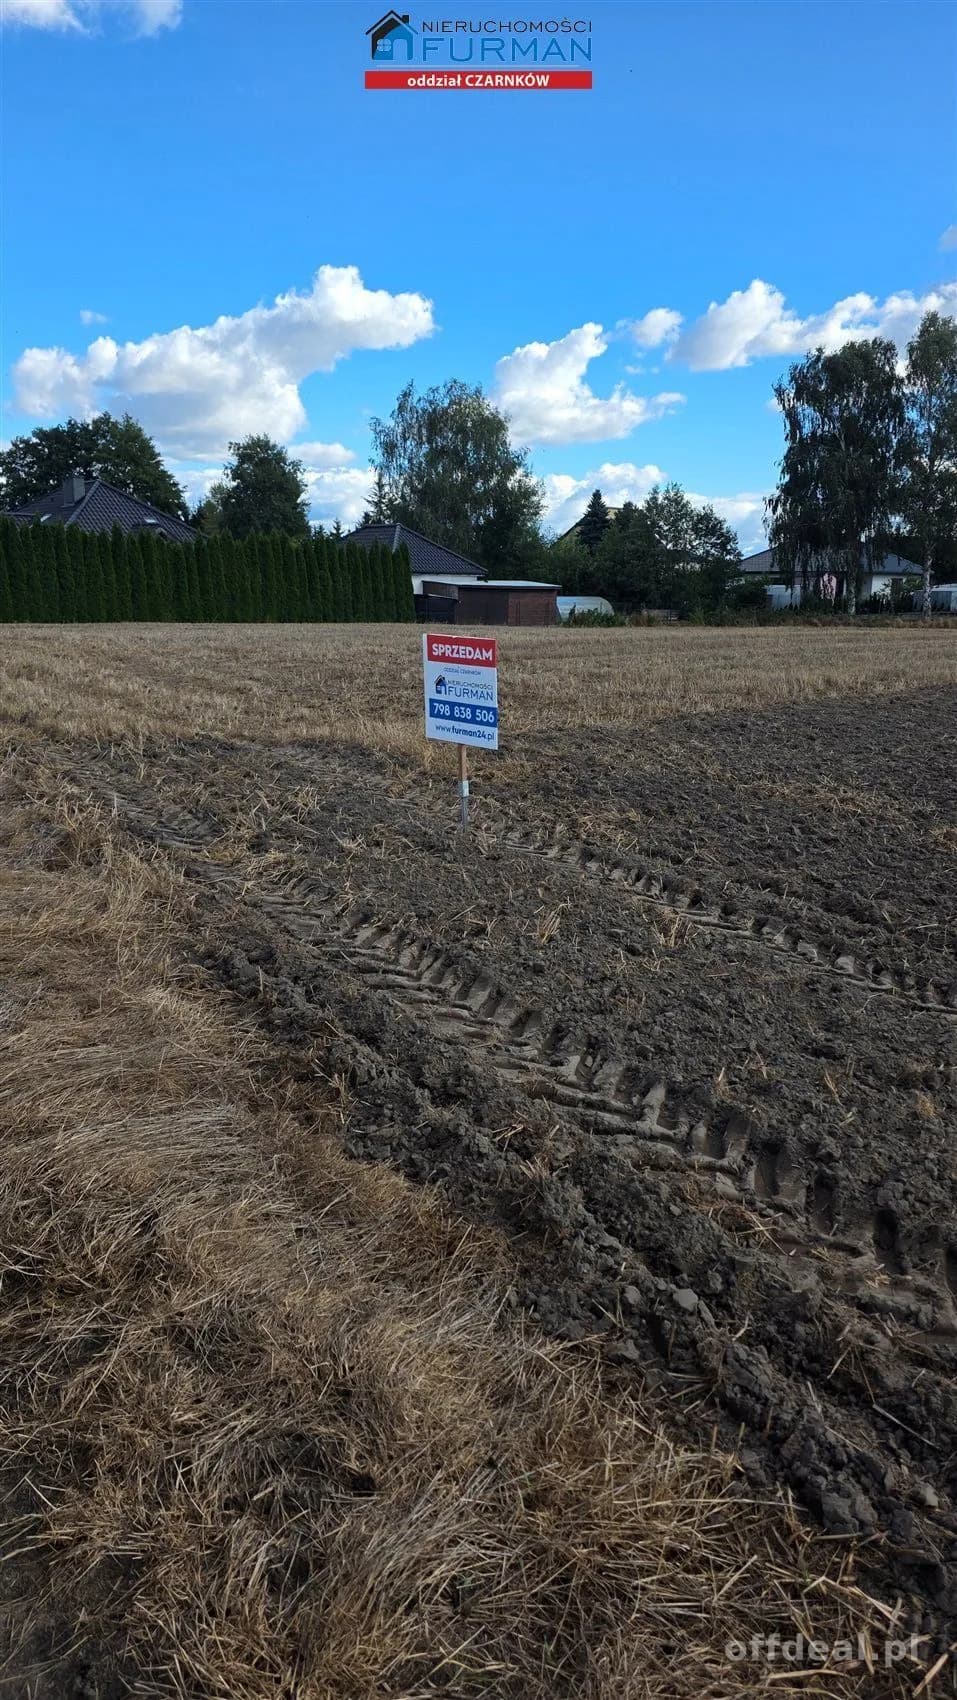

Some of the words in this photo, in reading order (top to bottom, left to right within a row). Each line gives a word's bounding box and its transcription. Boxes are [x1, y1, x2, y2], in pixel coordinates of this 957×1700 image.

[432, 643, 493, 661] SPRZEDAM
[447, 686, 494, 701] FURMAN
[433, 703, 450, 716] 798
[454, 706, 472, 720] 838
[476, 709, 495, 723] 506
[435, 724, 495, 741] www.furman24.pl
